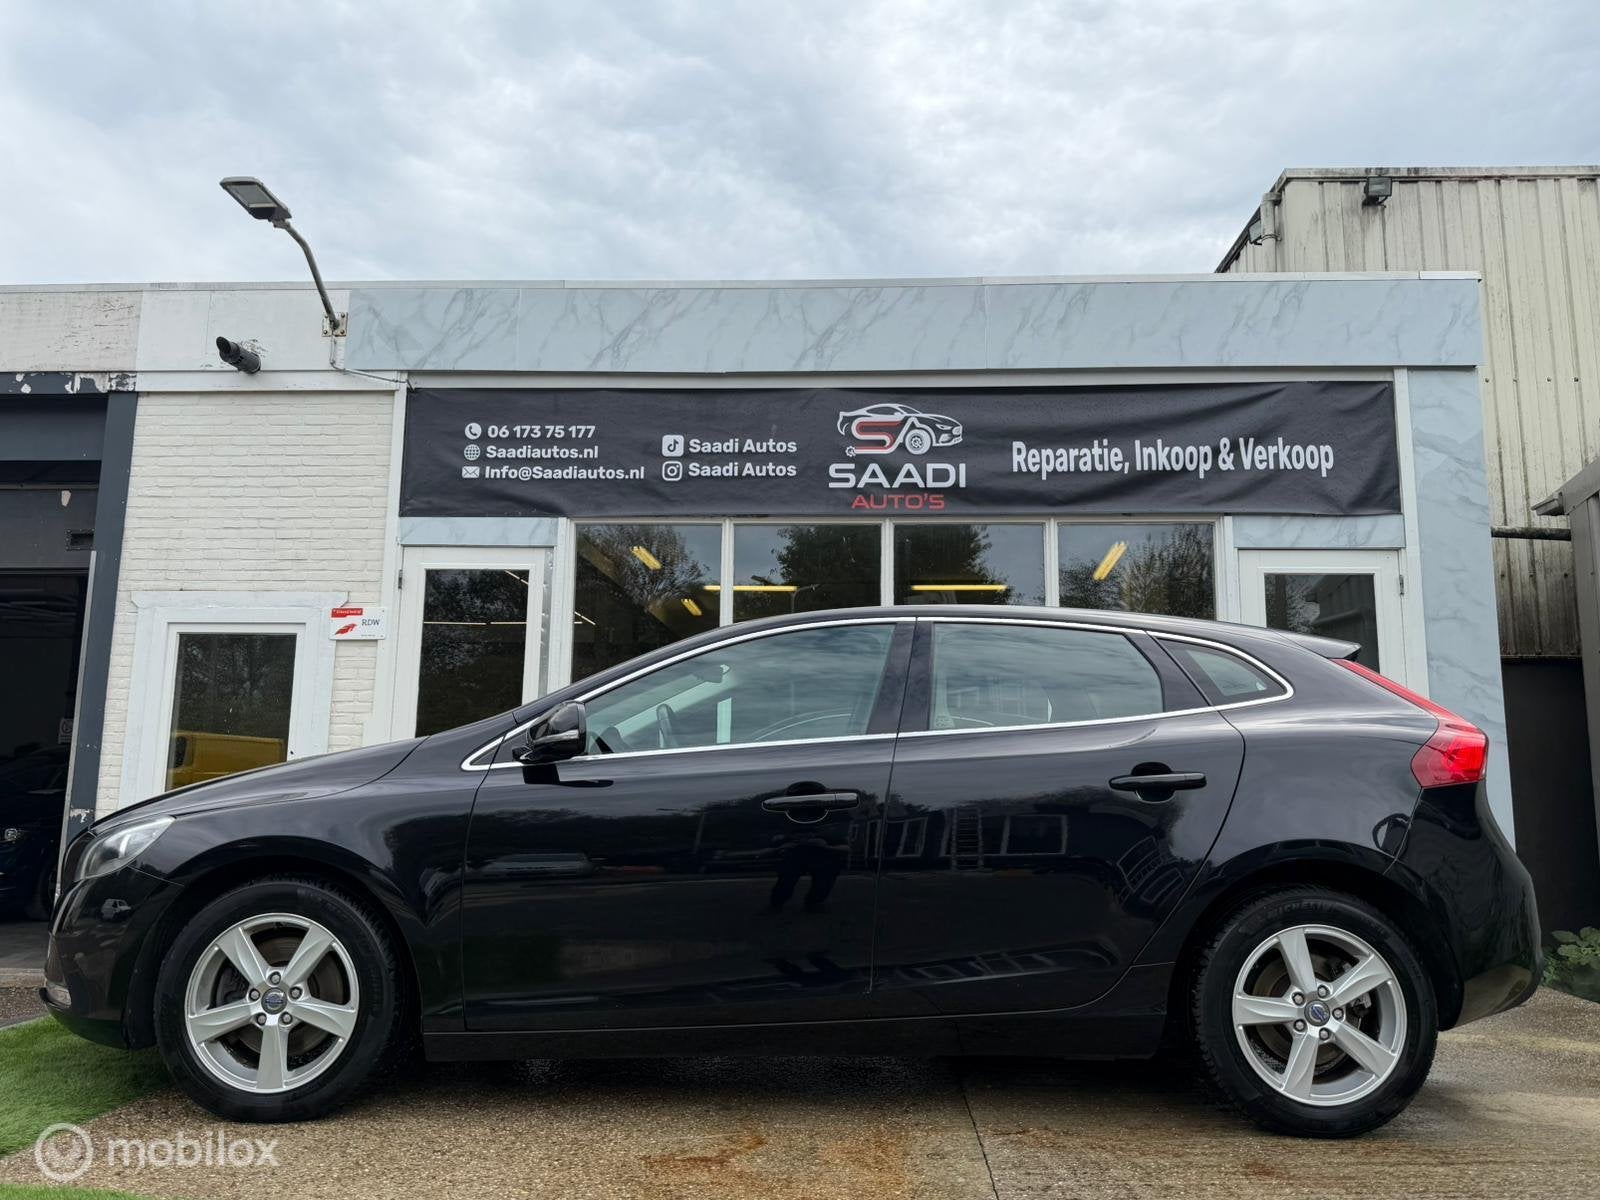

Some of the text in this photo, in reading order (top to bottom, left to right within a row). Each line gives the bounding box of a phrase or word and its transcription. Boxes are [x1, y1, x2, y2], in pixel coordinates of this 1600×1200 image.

[488, 425, 595, 438] 06 173 75 177
[486, 445, 598, 458] Saadiautos.nl
[689, 438, 797, 452] Saadi Autos
[1013, 437, 1334, 480] Reparatie, Inkoop & Verkoop
[485, 466, 644, 480] Info@Saadiautos.nl
[689, 462, 796, 476] Saadi Autos
[829, 463, 966, 488] SAADI
[852, 494, 945, 510] AUTO'S
[361, 618, 380, 626] RDW
